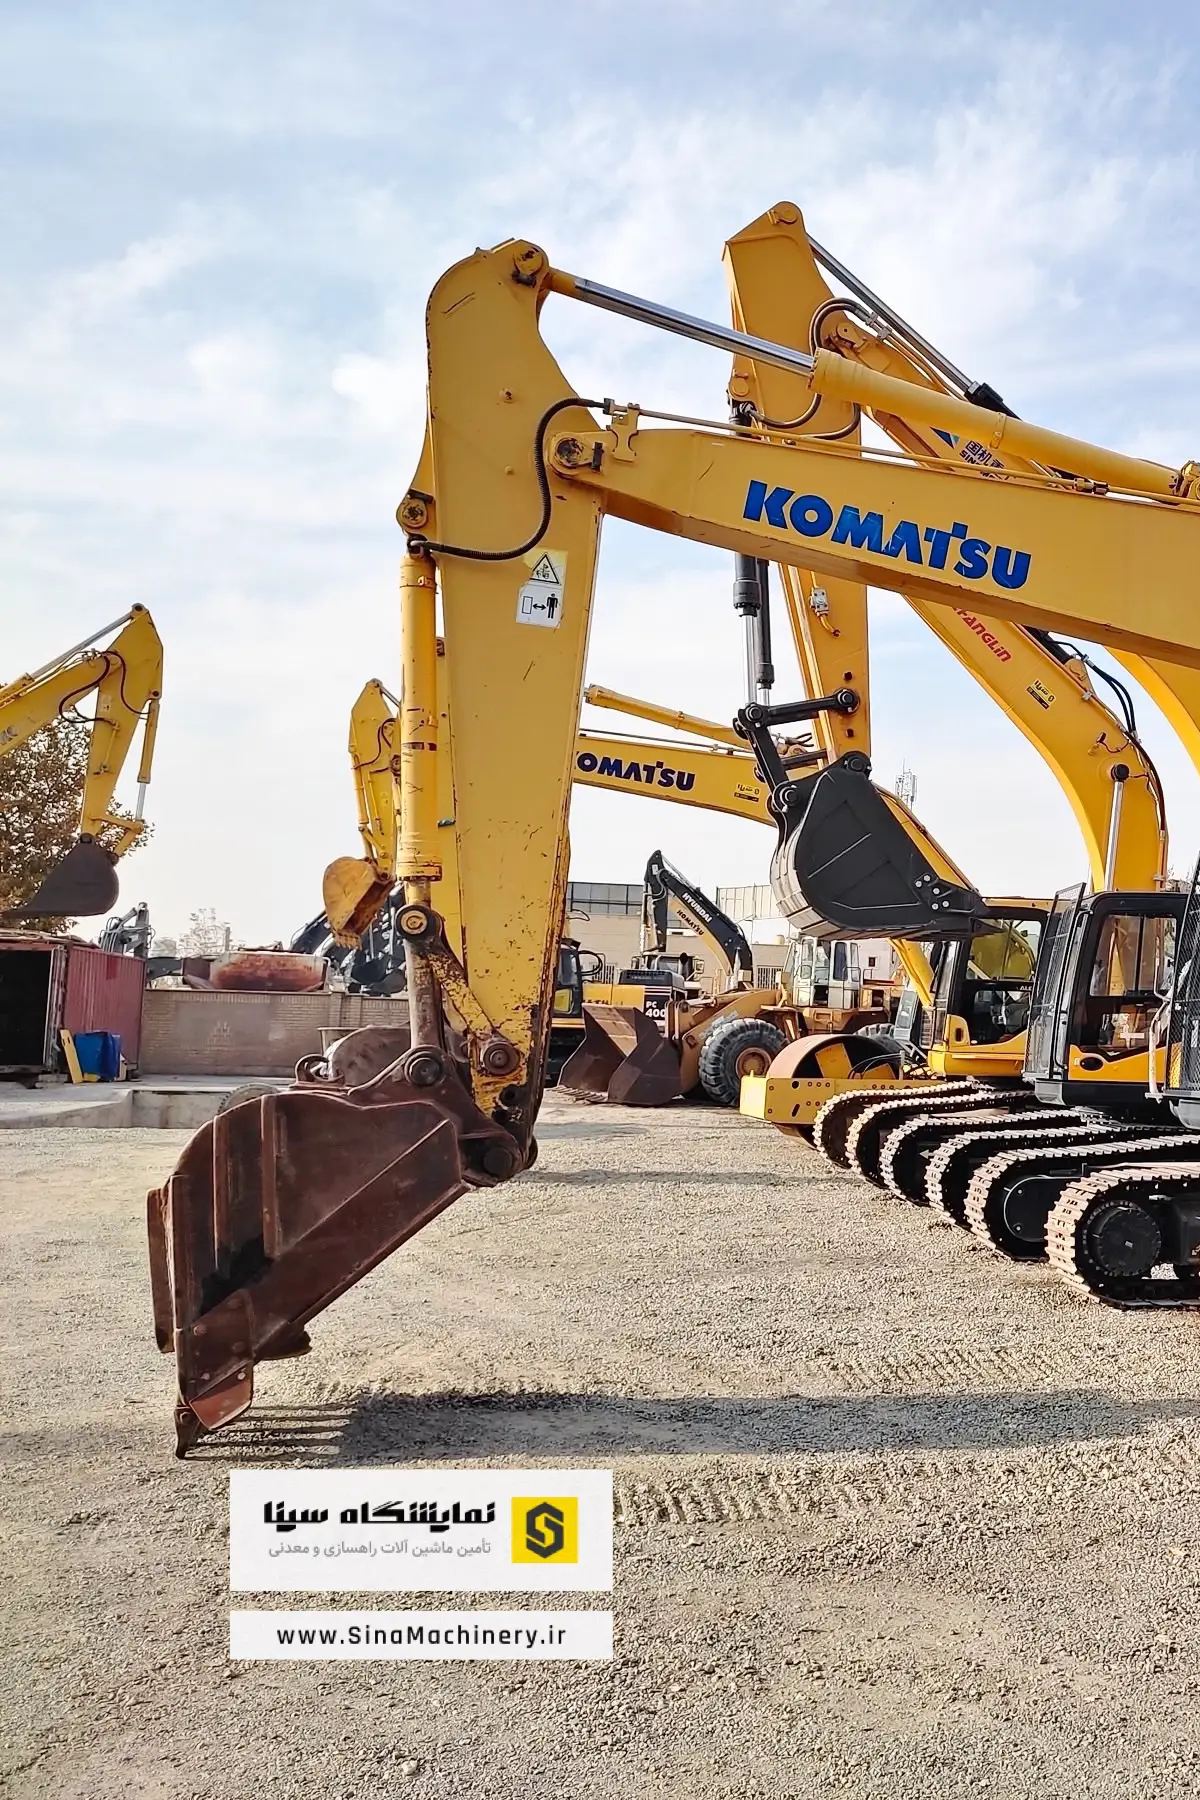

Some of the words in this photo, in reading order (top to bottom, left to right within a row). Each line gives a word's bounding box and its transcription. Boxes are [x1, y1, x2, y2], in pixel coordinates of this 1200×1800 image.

[743, 479, 1032, 590] KOMATSU
[575, 751, 696, 791] OMATSU
[676, 909, 705, 936] KOMATSU
[682, 892, 713, 923] HYUNDAI
